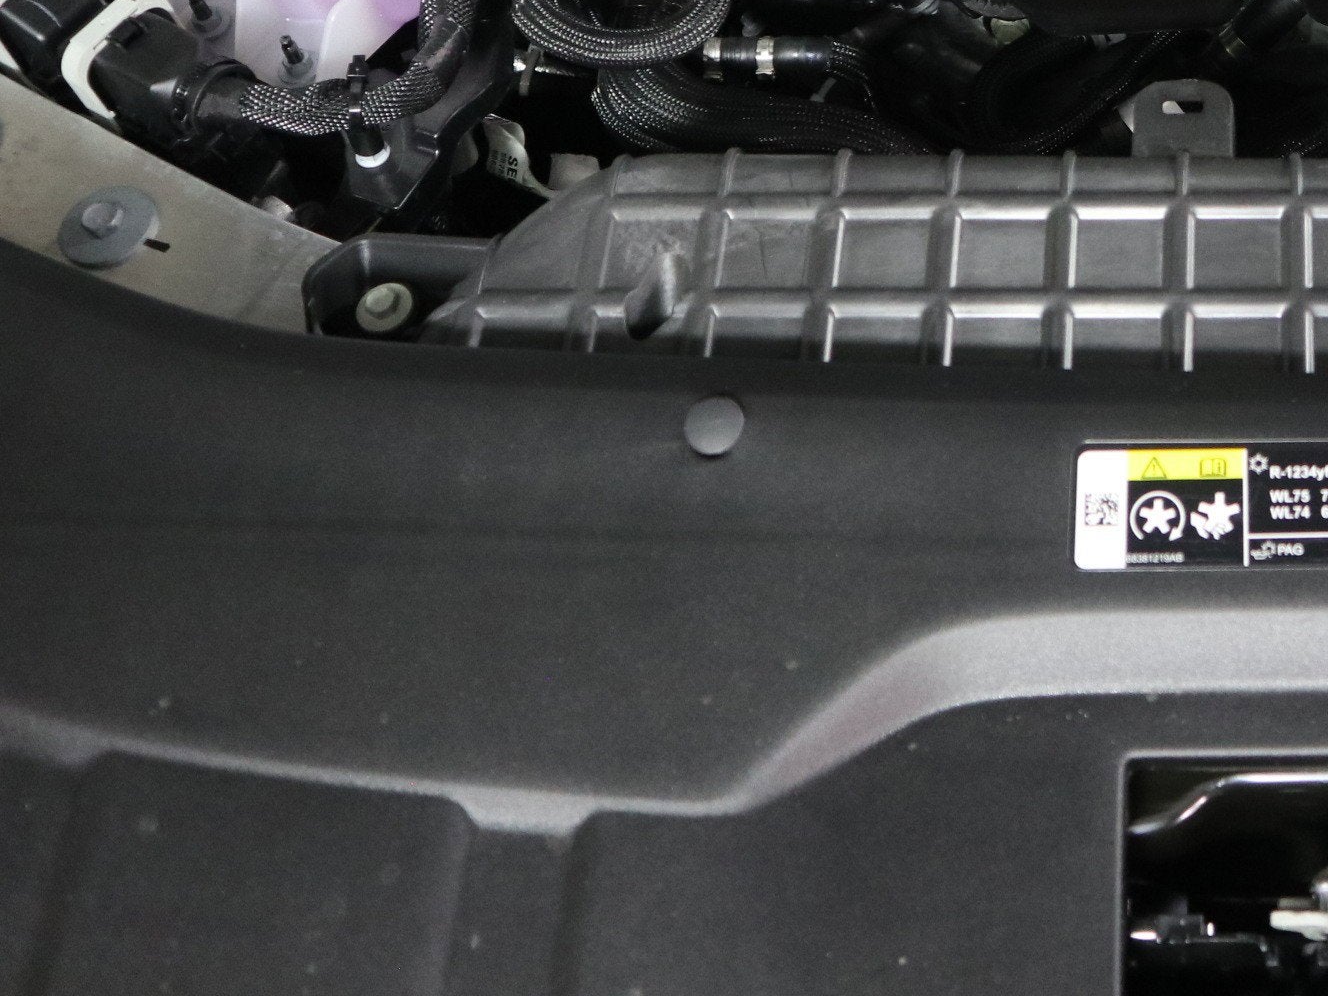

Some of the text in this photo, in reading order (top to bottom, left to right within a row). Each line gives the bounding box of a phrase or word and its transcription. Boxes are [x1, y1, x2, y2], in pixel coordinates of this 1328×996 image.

[1269, 488, 1311, 503] WL75
[1269, 505, 1312, 519] WL74
[1277, 543, 1305, 556] PAG
